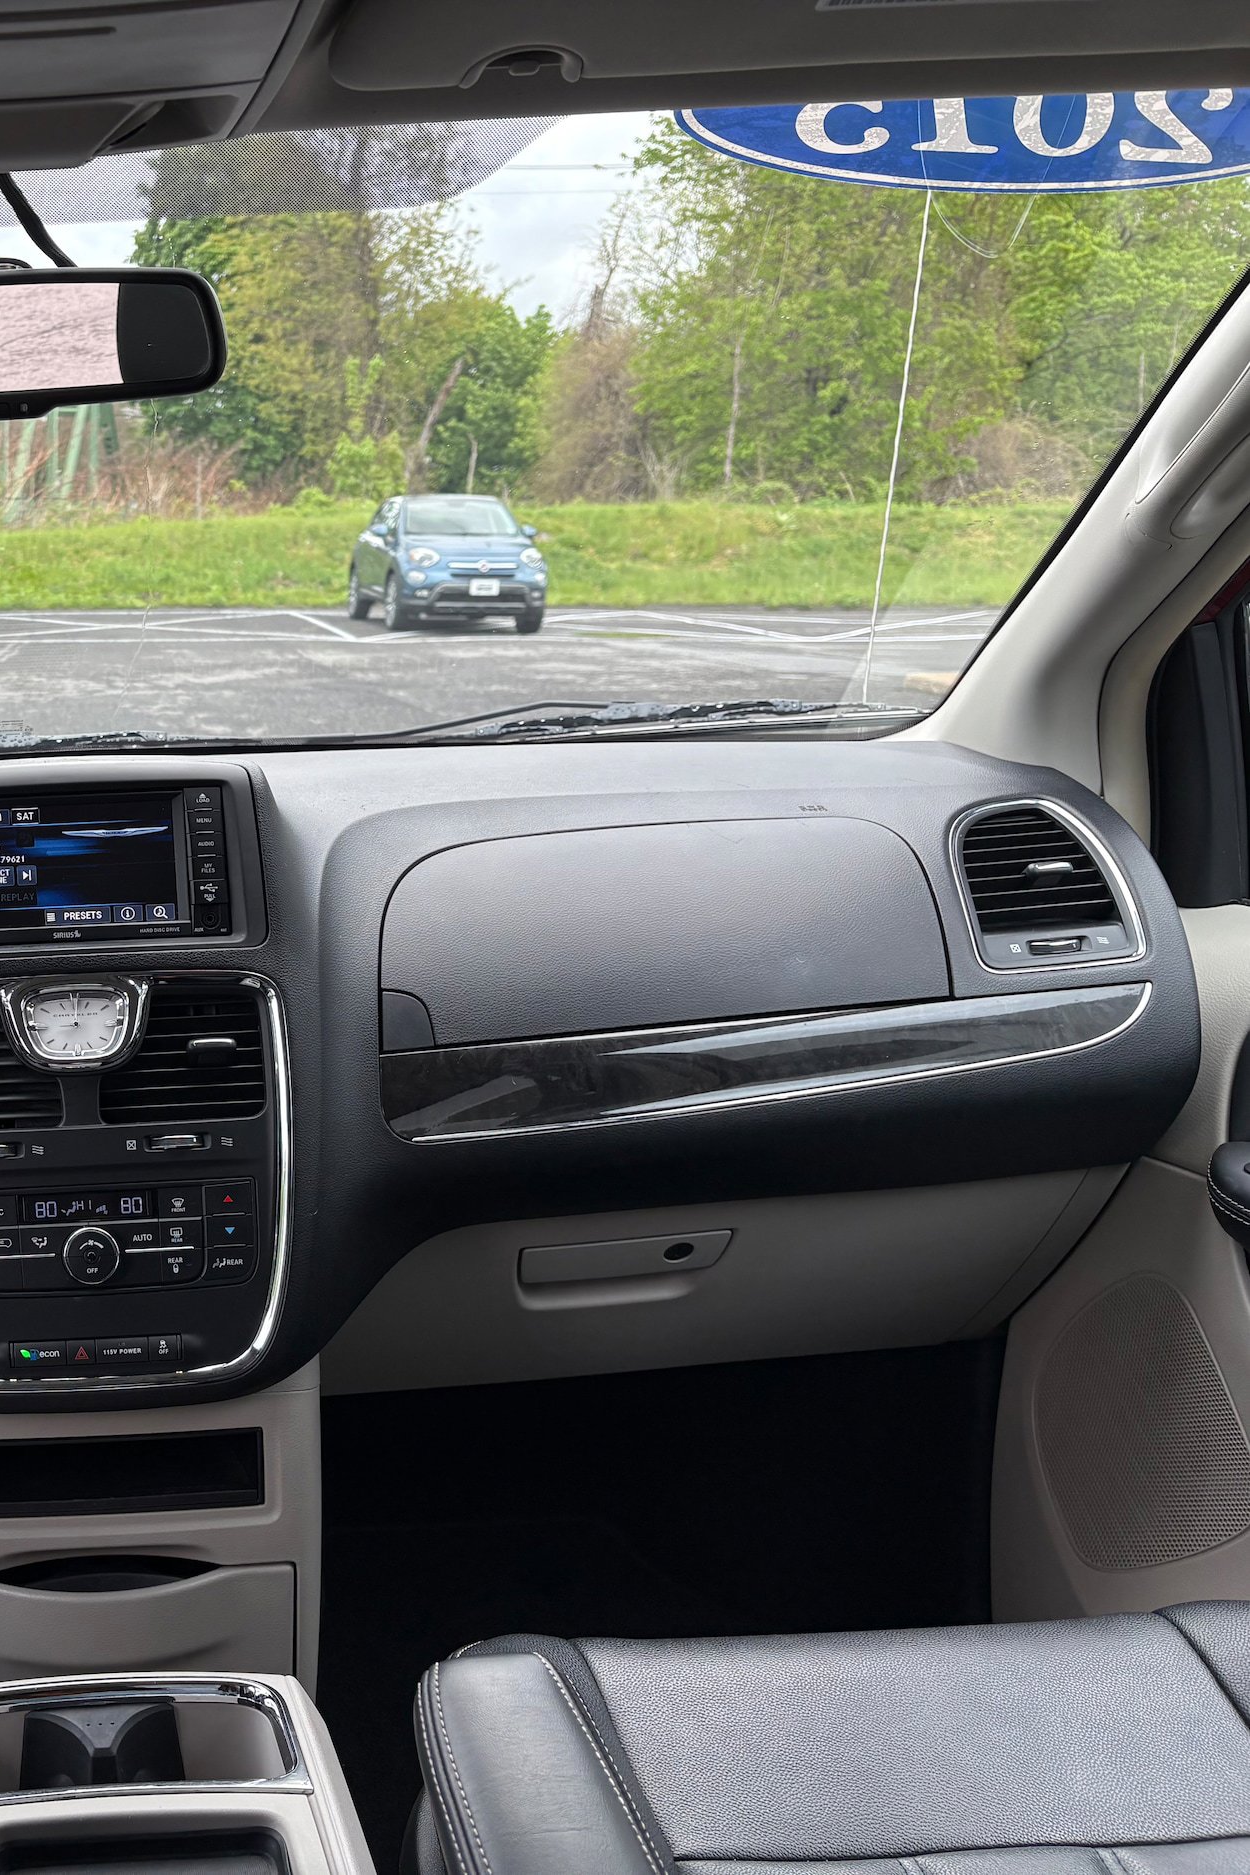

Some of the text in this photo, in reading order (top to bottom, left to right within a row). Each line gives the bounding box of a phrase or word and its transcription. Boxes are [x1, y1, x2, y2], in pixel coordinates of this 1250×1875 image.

[16, 812, 34, 821] SAT
[1, 892, 35, 902] REPLAY
[63, 910, 103, 921] PRESETS
[53, 931, 75, 939] SIRIUS
[35, 1201, 58, 1218] 80
[120, 1196, 143, 1214] 80
[132, 1234, 152, 1242] AUTO
[39, 1349, 60, 1358] econ
[119, 1347, 142, 1355] POWER
